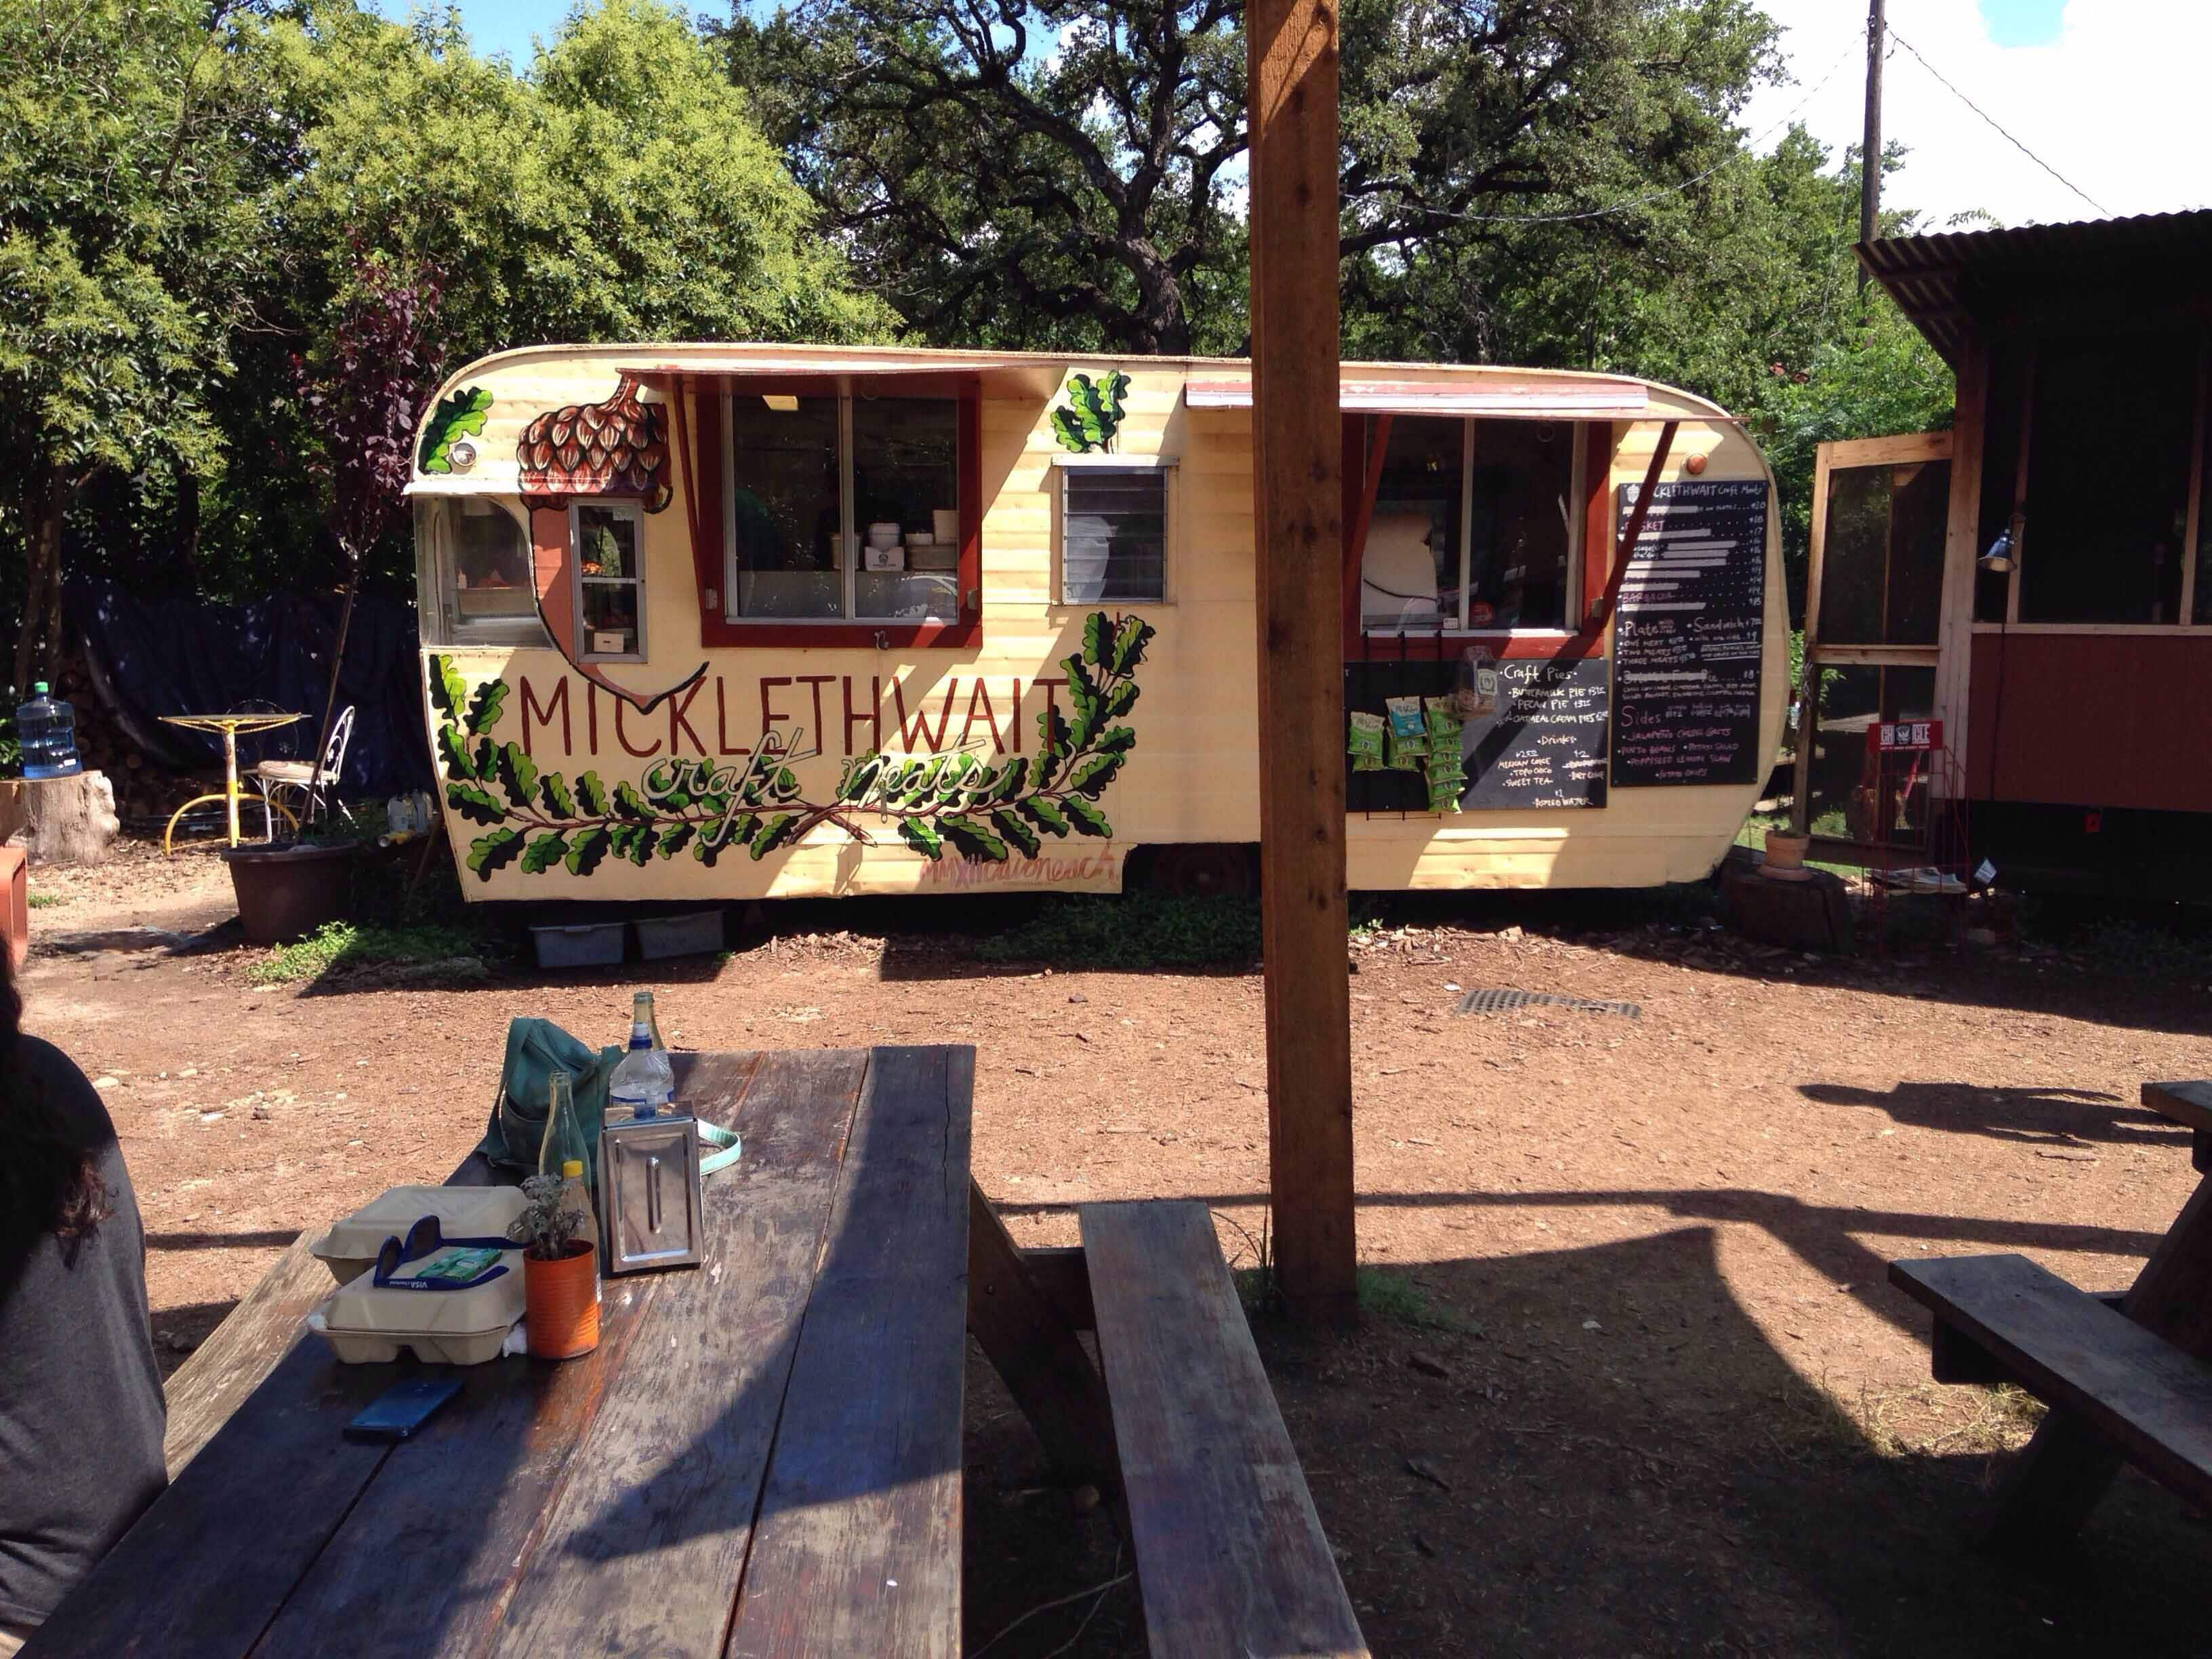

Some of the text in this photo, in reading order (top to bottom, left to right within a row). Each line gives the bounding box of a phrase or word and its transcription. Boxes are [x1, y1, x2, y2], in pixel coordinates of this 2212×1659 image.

[1624, 620, 1660, 637] Plate
[1693, 615, 1744, 633] Sandwich
[1503, 664, 1573, 684] Craft Pies
[1568, 687, 1587, 699] PIE
[1551, 699, 1570, 711] PIE
[520, 675, 1071, 758] MICKLETHWAIT
[1578, 712, 1596, 724] PIES
[1620, 705, 1661, 727] Sides
[1540, 734, 1574, 745] Drinks
[1530, 757, 1552, 766] COKE
[1512, 768, 1533, 777] TOPO
[1505, 777, 1554, 787] SWEET TEA
[411, 1281, 428, 1289] VISA
